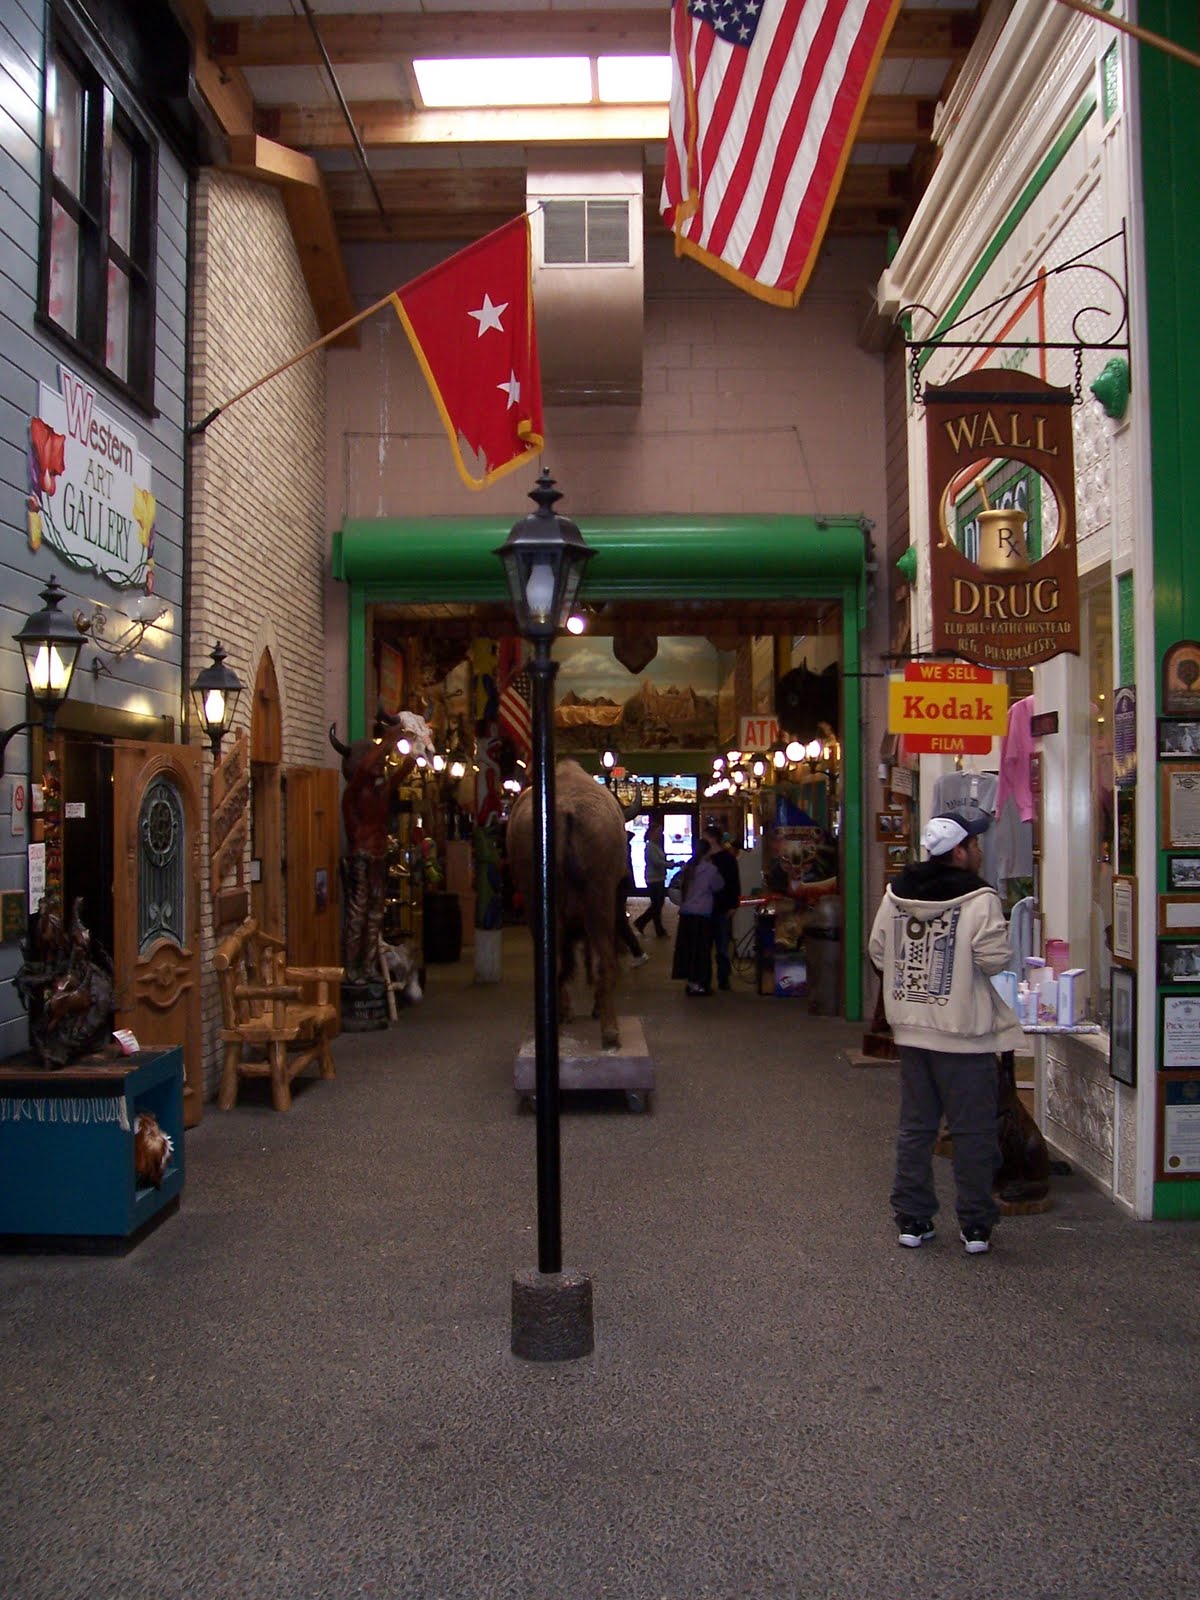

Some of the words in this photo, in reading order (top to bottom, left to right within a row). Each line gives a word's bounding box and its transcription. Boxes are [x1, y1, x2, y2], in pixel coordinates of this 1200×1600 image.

[63, 374, 133, 475] Western
[943, 409, 1059, 457] WALL
[84, 458, 115, 499] ART
[63, 483, 132, 563] GALLERY
[952, 576, 1059, 619] DRUG
[984, 638, 1056, 661] PHARMACISTS
[919, 665, 942, 680] WE
[947, 666, 978, 681] SELL
[902, 695, 994, 722] Kodak
[931, 737, 965, 751] FILM
